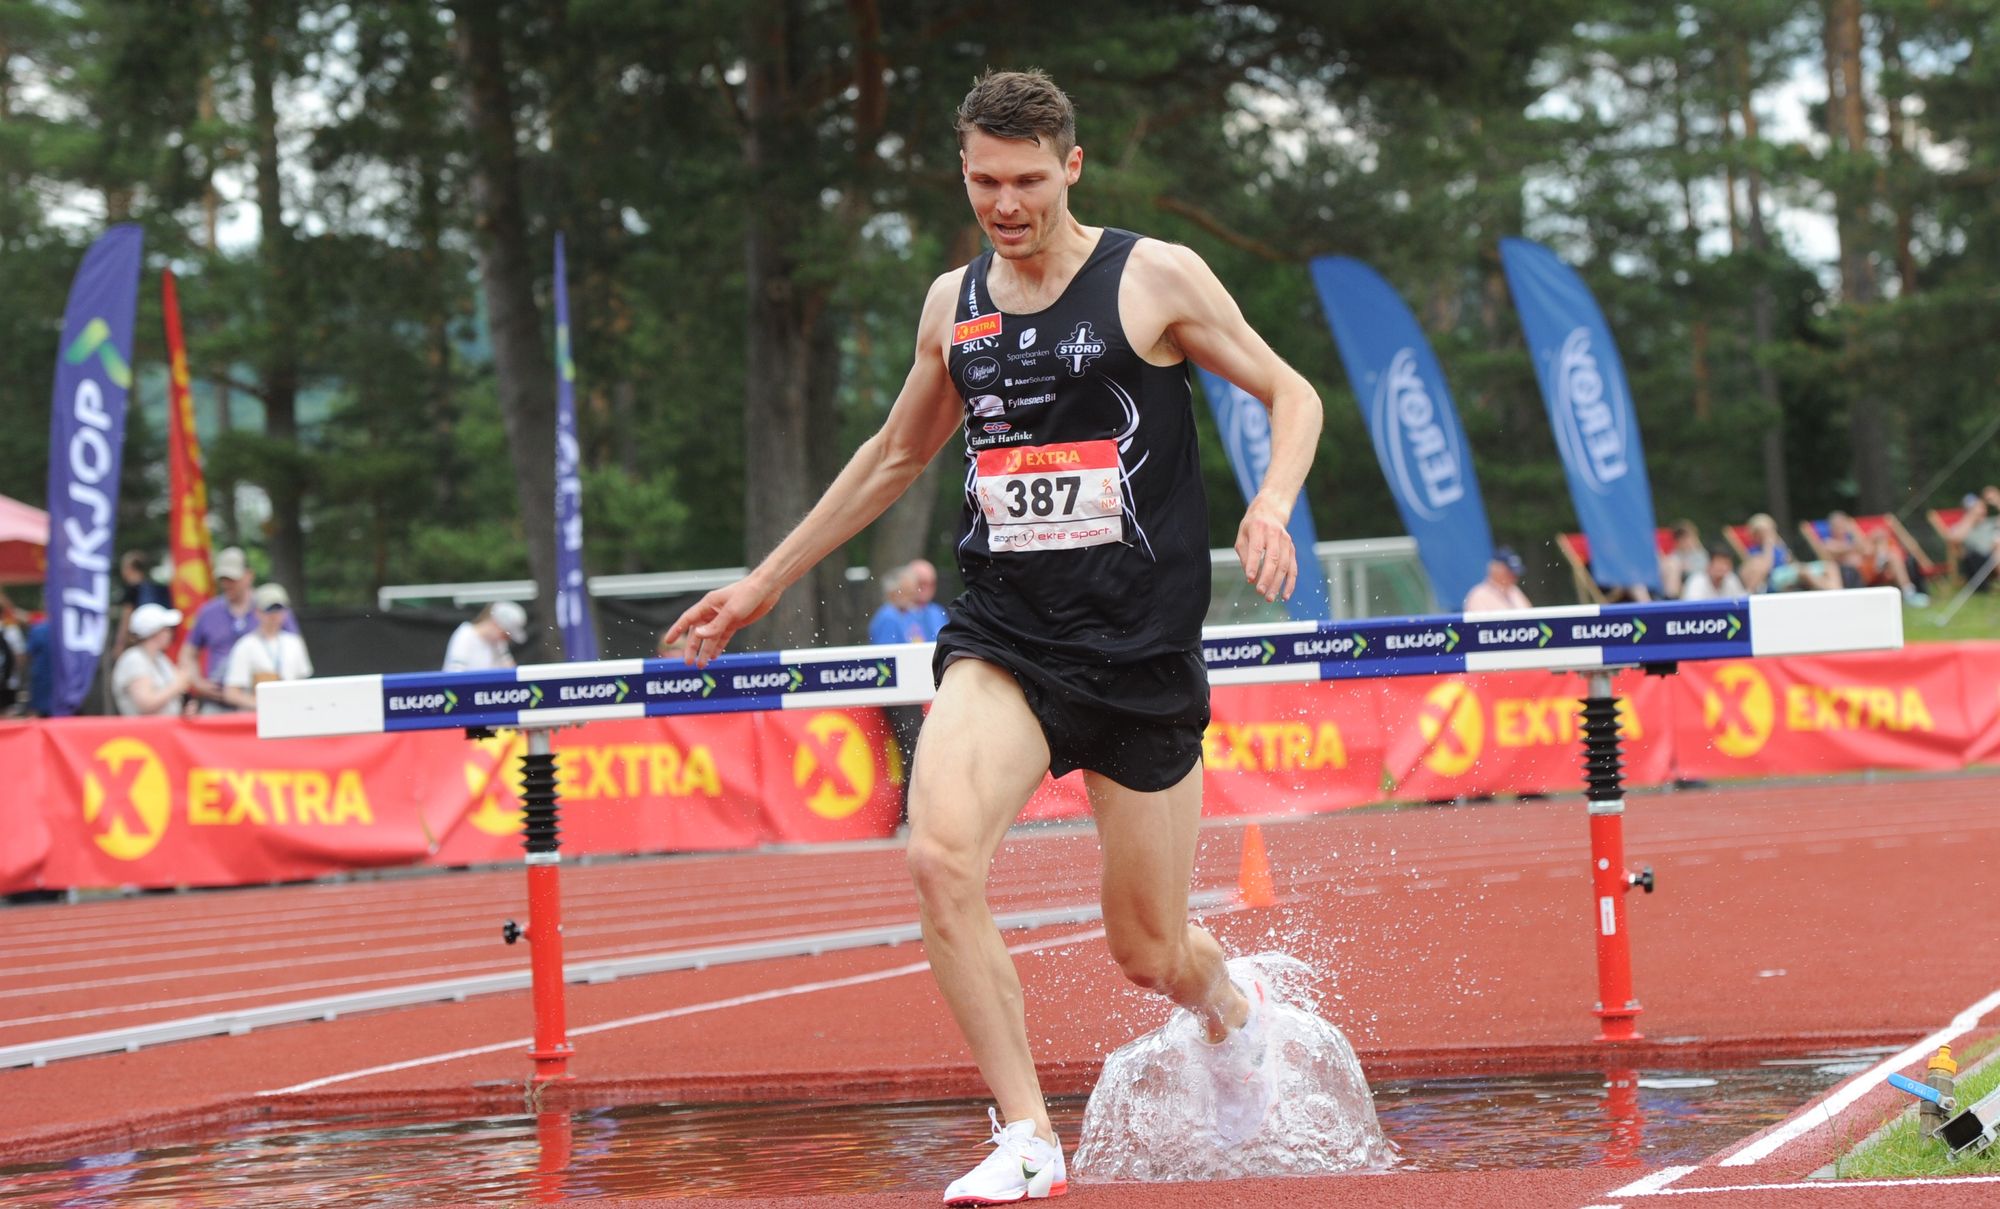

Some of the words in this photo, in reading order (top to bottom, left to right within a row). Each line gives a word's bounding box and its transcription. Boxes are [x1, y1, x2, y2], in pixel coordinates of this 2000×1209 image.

[970, 321, 996, 333] EXTRA
[962, 339, 984, 354] SKL
[1060, 344, 1101, 354] STORD
[1006, 350, 1050, 362] Sparebanken
[1021, 358, 1037, 367] Vest
[1008, 395, 1044, 408] Fylkesnes
[1045, 393, 1056, 403] Bil
[998, 431, 1033, 443] Havfiske
[1026, 450, 1081, 466] EXTRA
[1005, 476, 1081, 518] 387
[1101, 498, 1118, 510] NM
[1786, 683, 1935, 732] EXTRA
[1203, 720, 1347, 772] EXTRA
[560, 743, 722, 799] EXTRA
[187, 768, 374, 825] EXTRA
